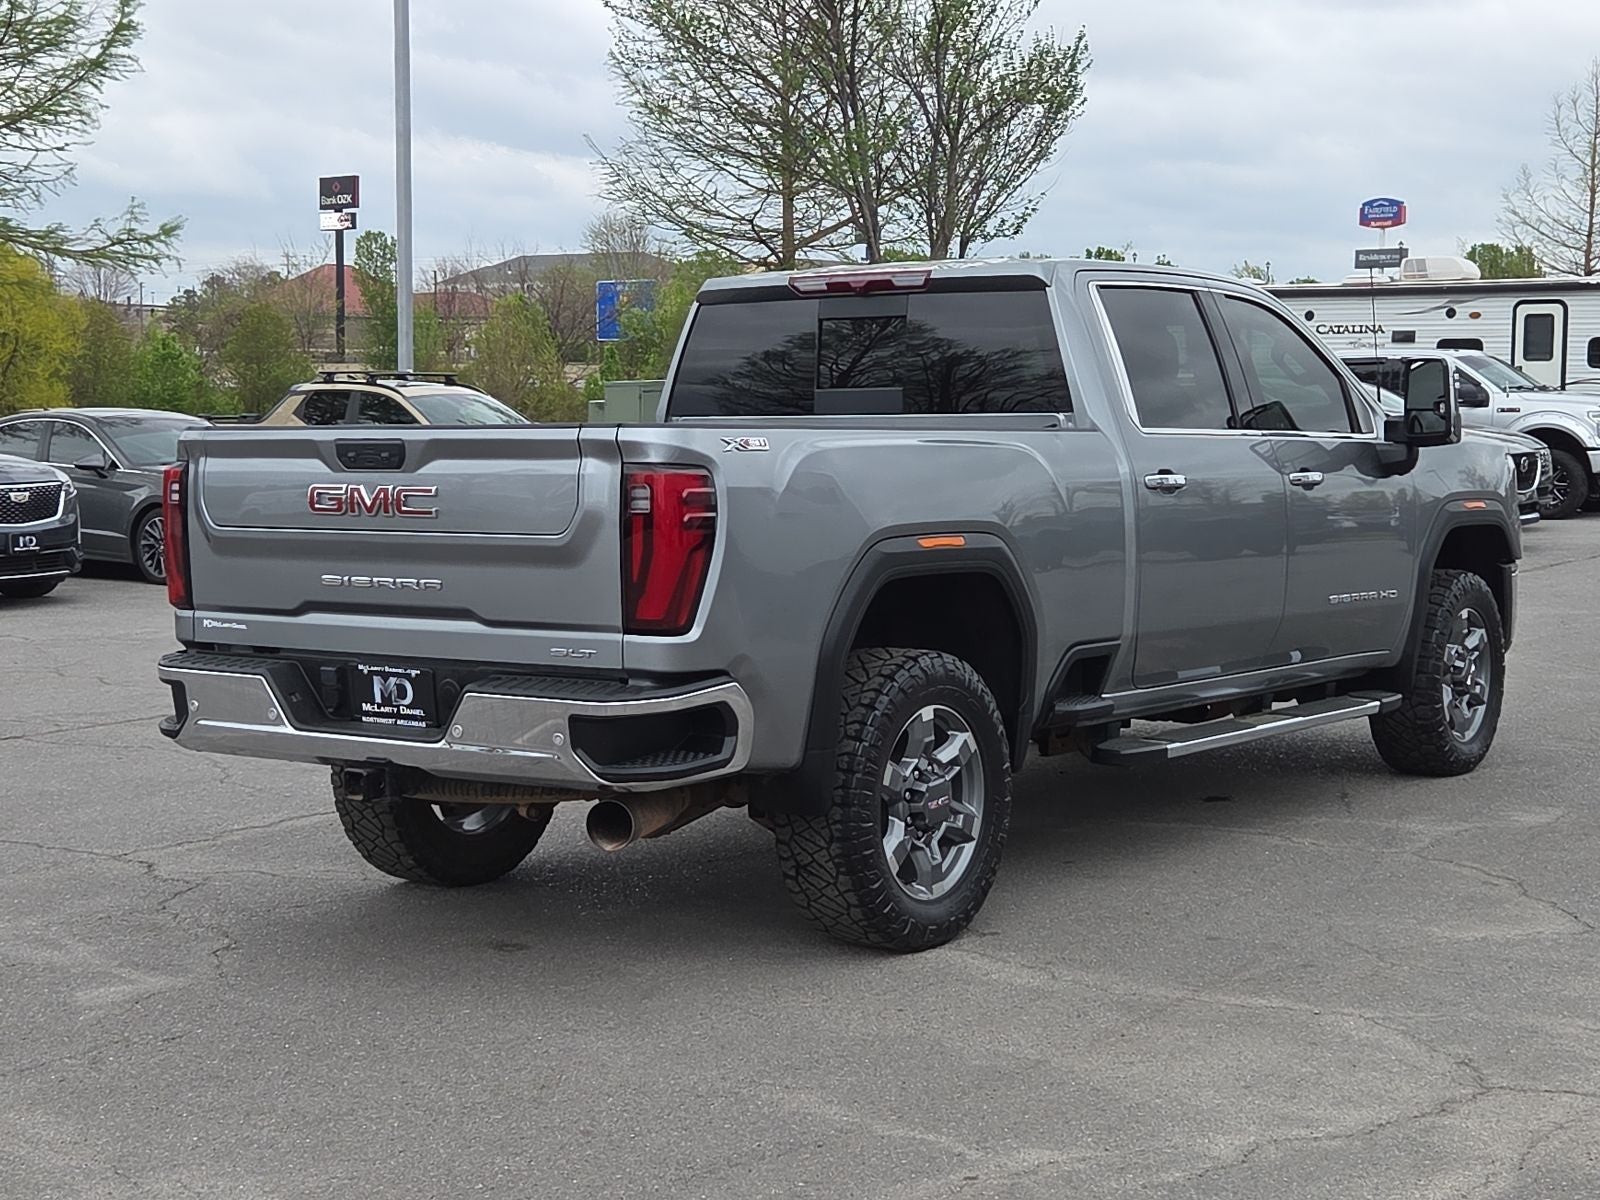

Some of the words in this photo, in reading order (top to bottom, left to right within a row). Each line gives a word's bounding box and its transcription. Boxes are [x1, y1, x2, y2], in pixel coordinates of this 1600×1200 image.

[337, 194, 352, 204] OZK
[1316, 324, 1385, 335] CATALINA
[308, 484, 439, 518] GMC
[321, 574, 443, 590] SIERRA
[1328, 591, 1378, 604] SIERRA
[1379, 589, 1397, 599] HD
[550, 647, 597, 658] SLT
